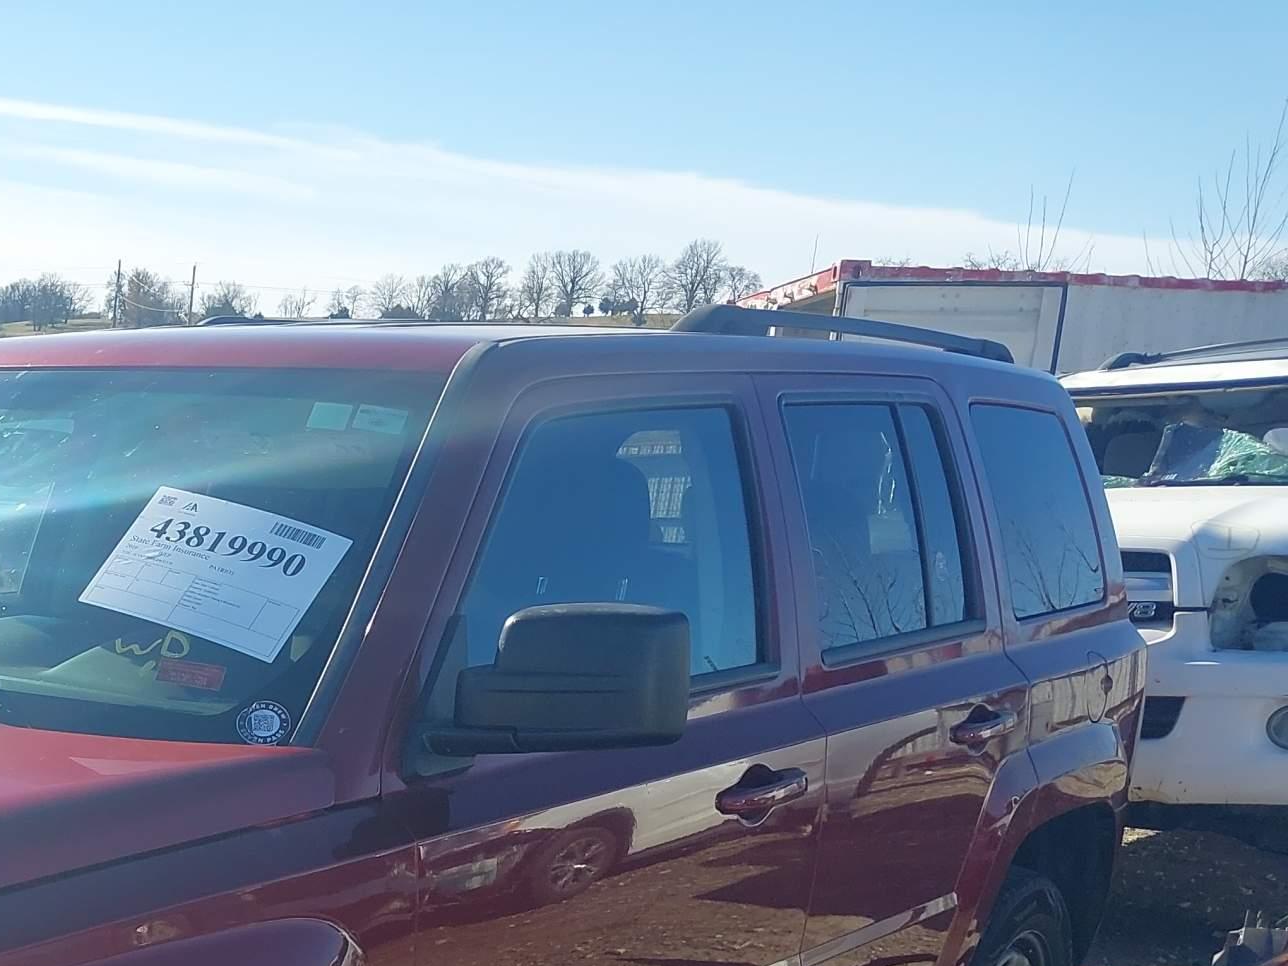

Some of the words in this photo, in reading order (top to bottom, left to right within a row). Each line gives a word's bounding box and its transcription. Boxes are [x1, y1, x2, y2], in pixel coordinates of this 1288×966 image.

[130, 534, 151, 546] State
[152, 539, 172, 551] Farm
[173, 545, 211, 561] Insurance
[150, 518, 307, 577] 43819990
